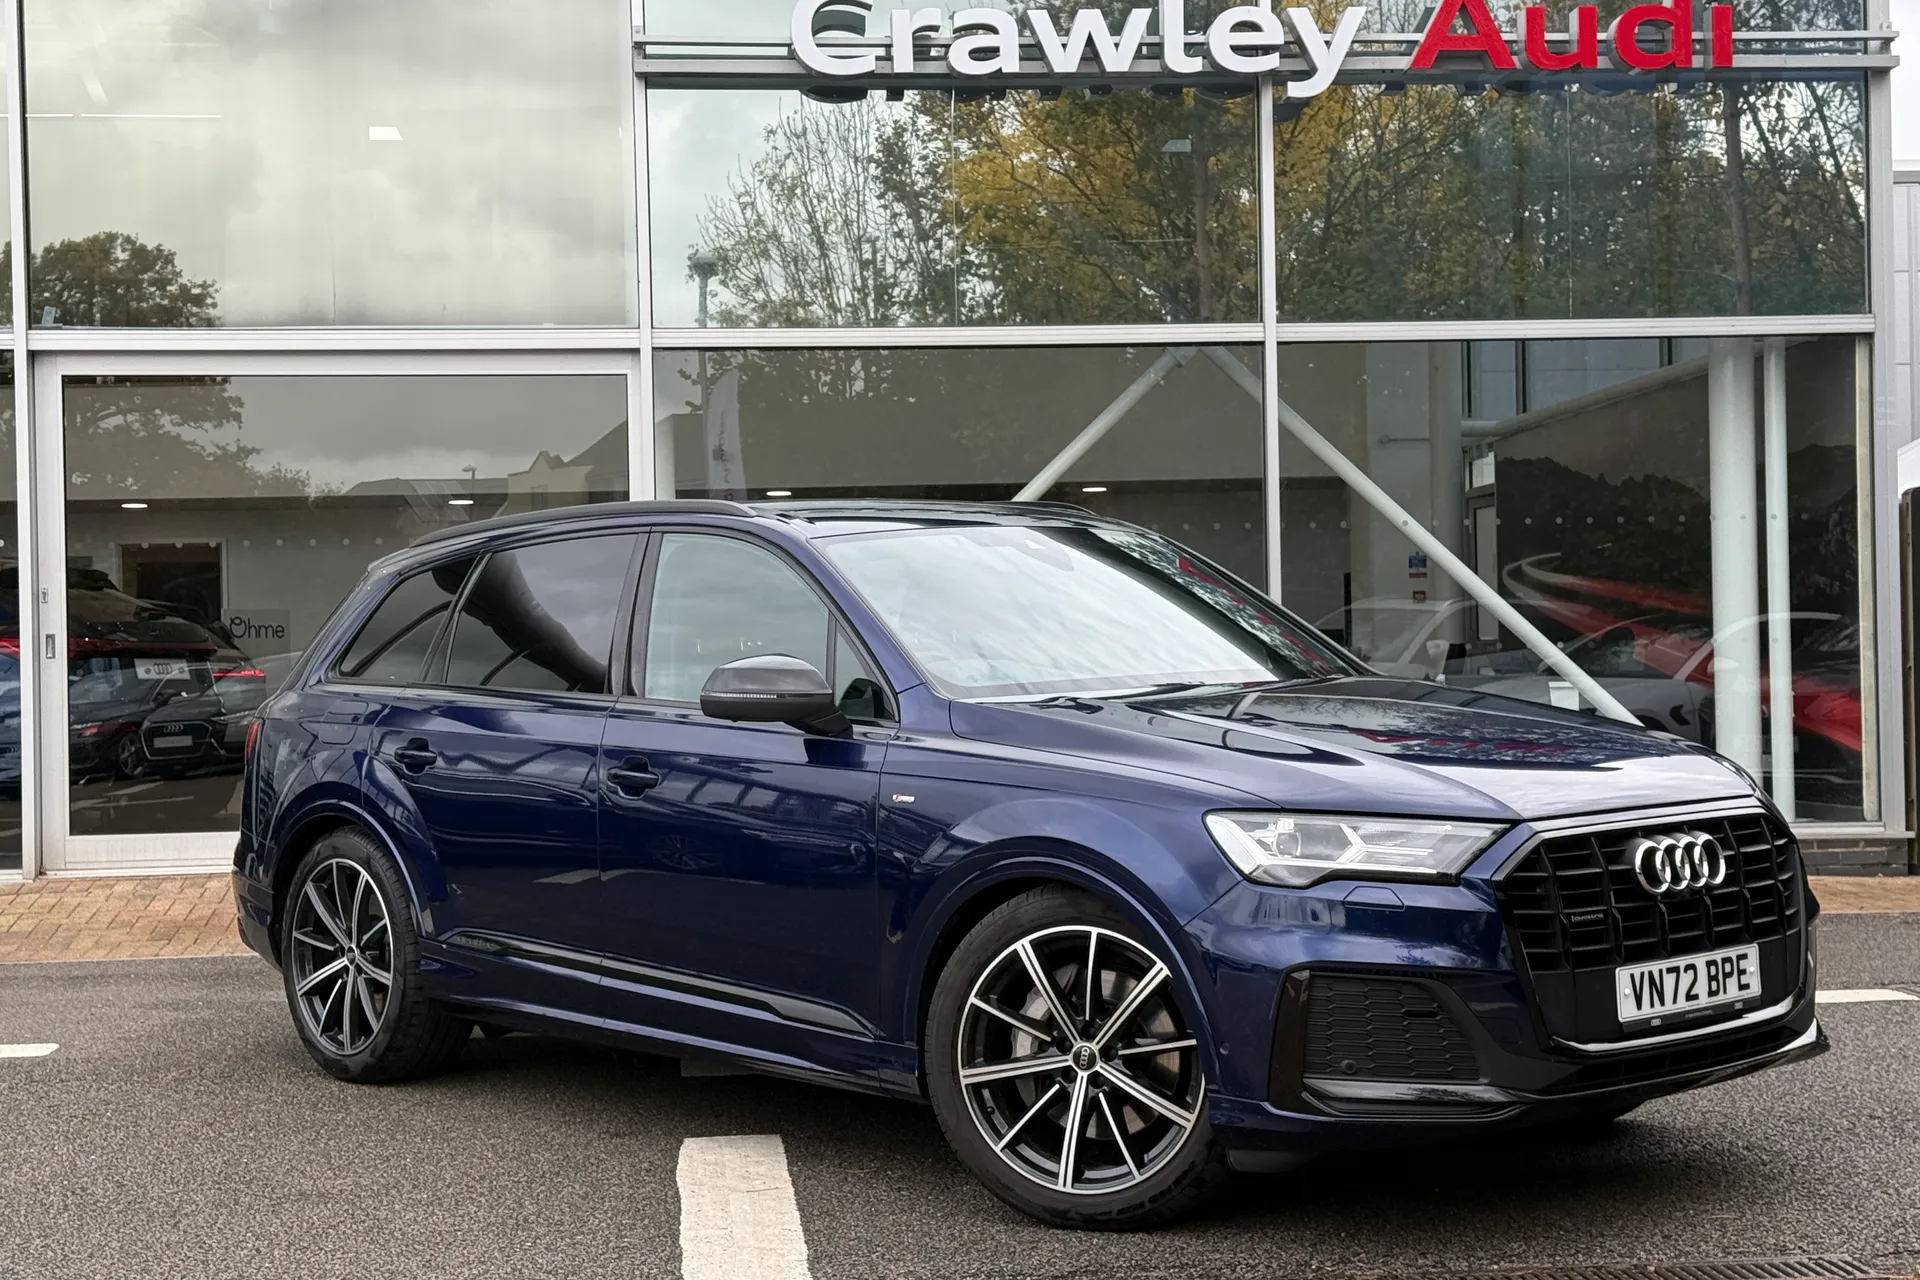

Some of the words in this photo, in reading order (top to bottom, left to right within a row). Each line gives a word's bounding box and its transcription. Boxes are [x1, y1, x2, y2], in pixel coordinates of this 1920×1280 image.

[792, 0, 1367, 98] Crawley
[1411, 0, 1733, 70] Audi
[230, 616, 285, 639] Ohme
[1630, 963, 1699, 1011] VN72
[1705, 953, 1751, 998] BPE
